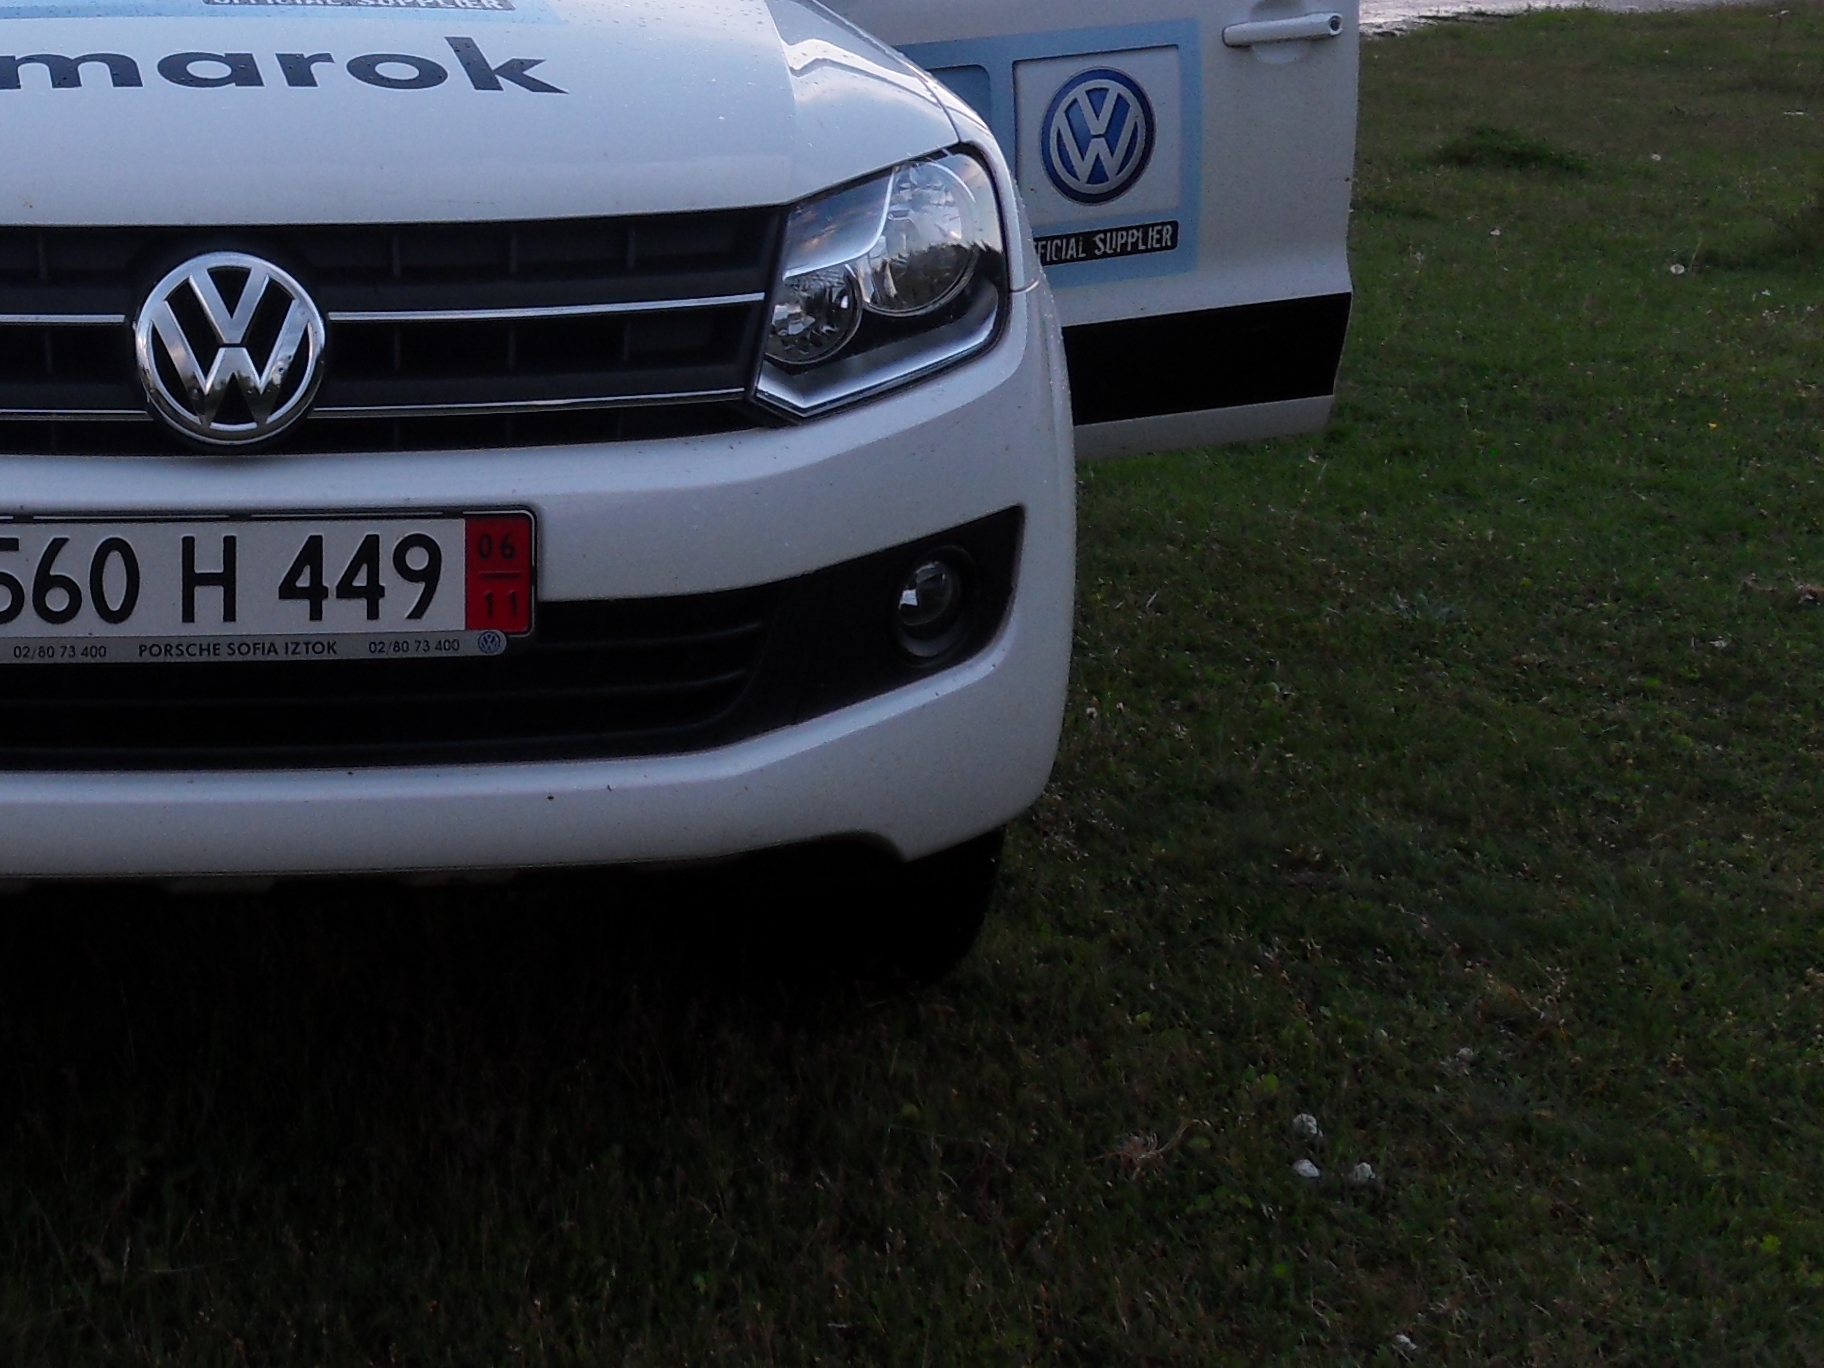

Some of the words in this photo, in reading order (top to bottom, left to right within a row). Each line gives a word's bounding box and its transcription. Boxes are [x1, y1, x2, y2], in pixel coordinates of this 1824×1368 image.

[1033, 235, 1087, 263] FICIAL
[1092, 224, 1174, 256] SUPPLIER
[478, 533, 518, 561] 06
[180, 534, 238, 624] H
[278, 532, 443, 622] 449
[482, 589, 520, 618] 11
[13, 644, 55, 660] 02/80
[59, 644, 77, 659] 73
[80, 644, 108, 659] 400
[138, 642, 222, 658] PORSCHE
[226, 641, 278, 657] SOFIA
[284, 640, 338, 656] IZTOK
[368, 638, 410, 655] 02/80
[414, 638, 430, 653] 73
[434, 637, 461, 652] 400
